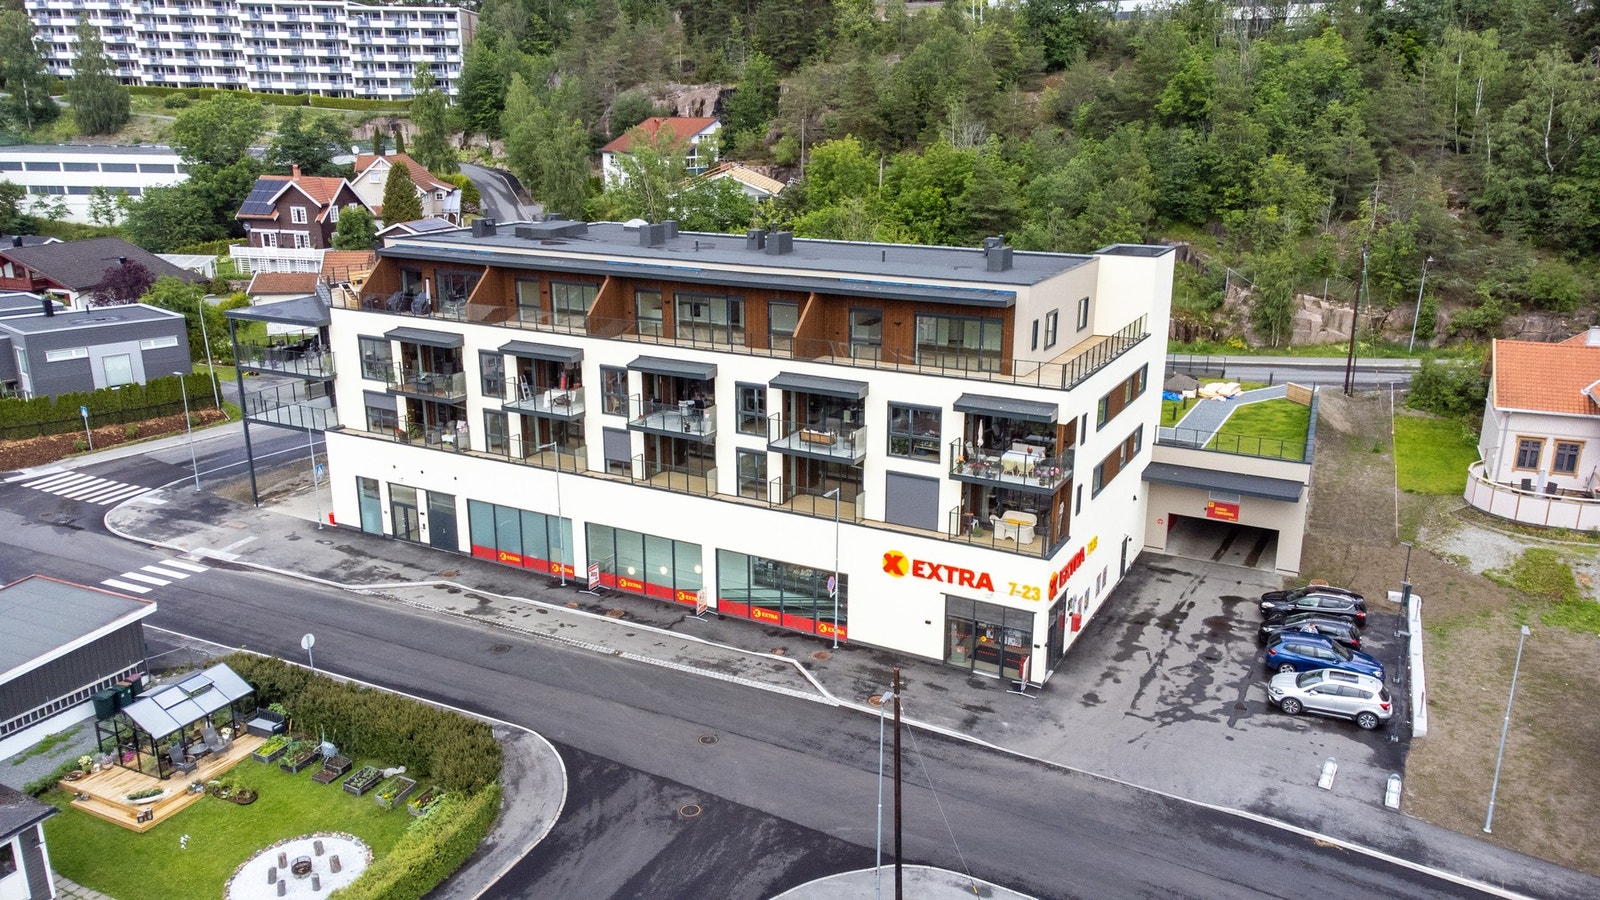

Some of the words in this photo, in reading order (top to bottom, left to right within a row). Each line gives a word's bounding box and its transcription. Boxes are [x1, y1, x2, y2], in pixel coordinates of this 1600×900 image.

[912, 559, 995, 592] EXTRA
[1059, 546, 1085, 588] EXTRA
[1009, 581, 1041, 601] 7-23
[761, 611, 778, 620] EXTRA
